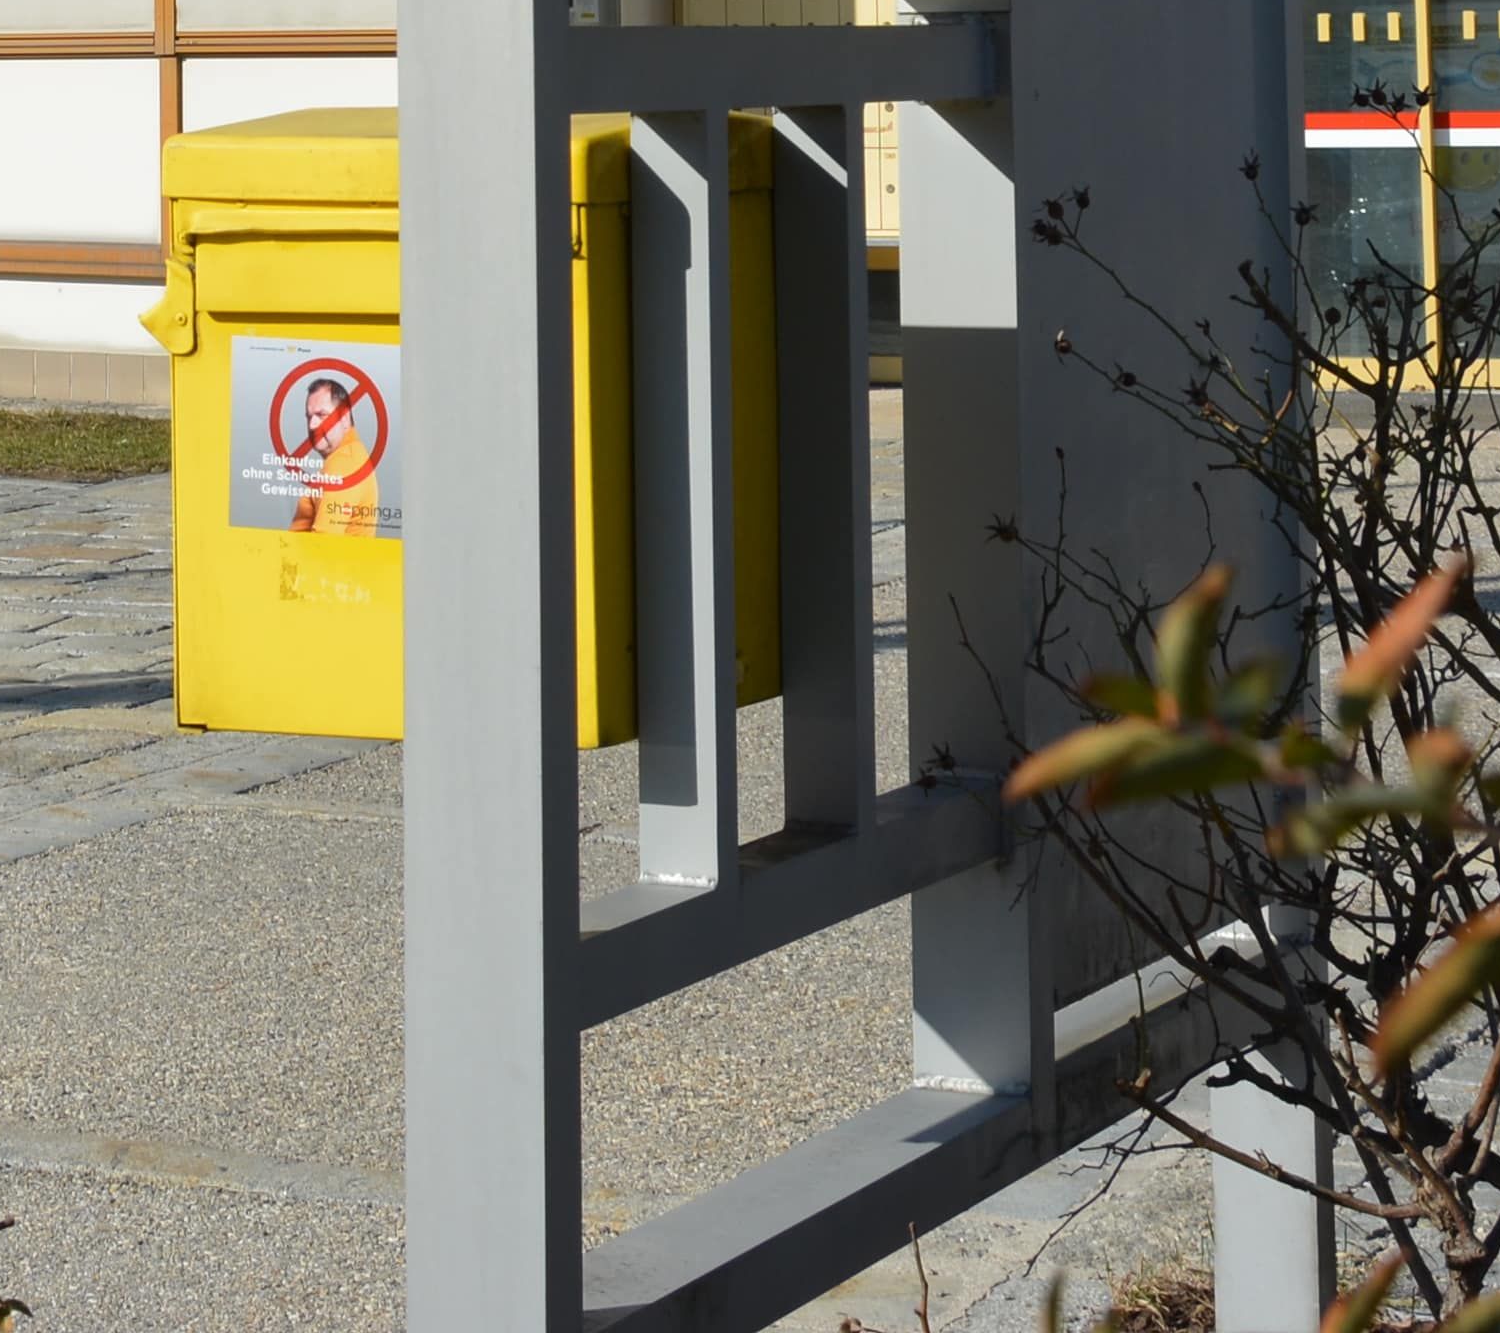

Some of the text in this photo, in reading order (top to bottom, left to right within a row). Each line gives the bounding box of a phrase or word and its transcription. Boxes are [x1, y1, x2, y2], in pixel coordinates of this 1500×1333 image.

[262, 453, 324, 468] Einkaufen
[242, 467, 344, 485] ohne Schlechtes
[261, 483, 324, 498] Gewissen!
